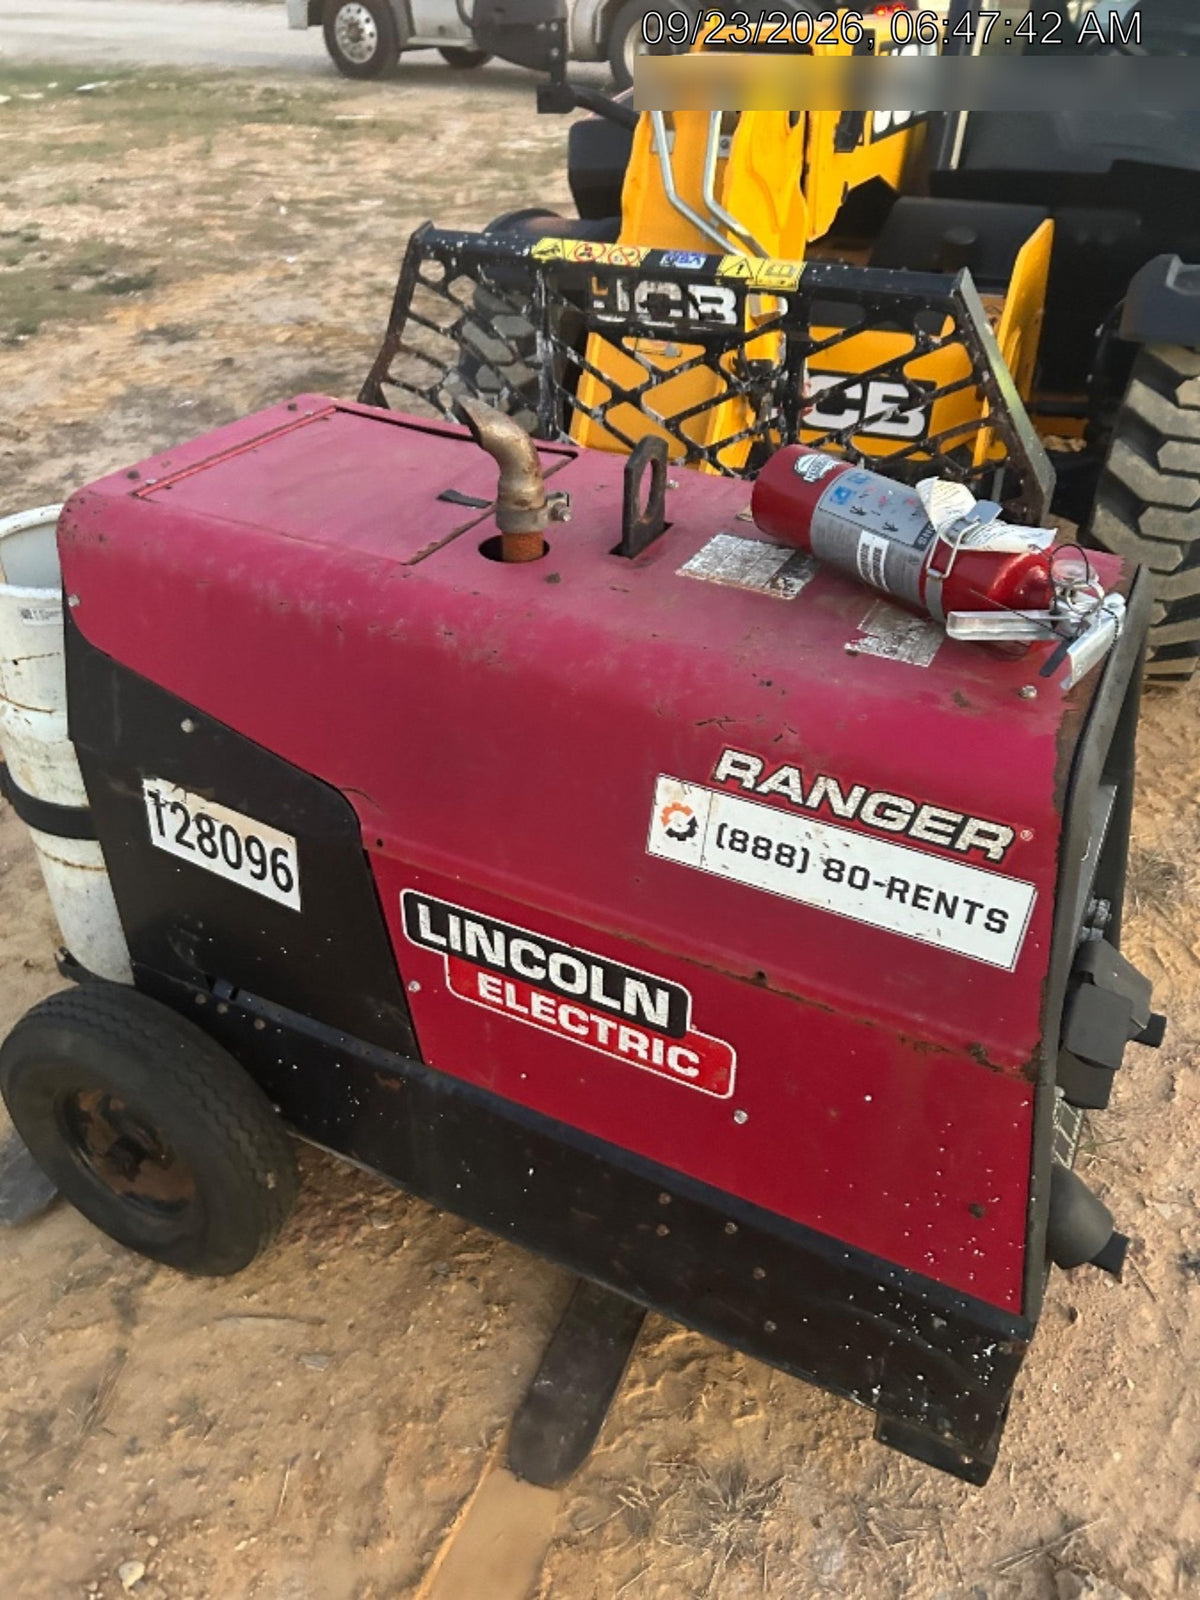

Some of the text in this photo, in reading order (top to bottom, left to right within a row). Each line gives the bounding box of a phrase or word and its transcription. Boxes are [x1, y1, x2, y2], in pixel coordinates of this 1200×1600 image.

[800, 375, 926, 437] CB
[716, 822, 1010, 935] (888) 80-RENTS
[417, 902, 670, 1028] LINCOLN
[477, 971, 701, 1079] ELECTRIC
